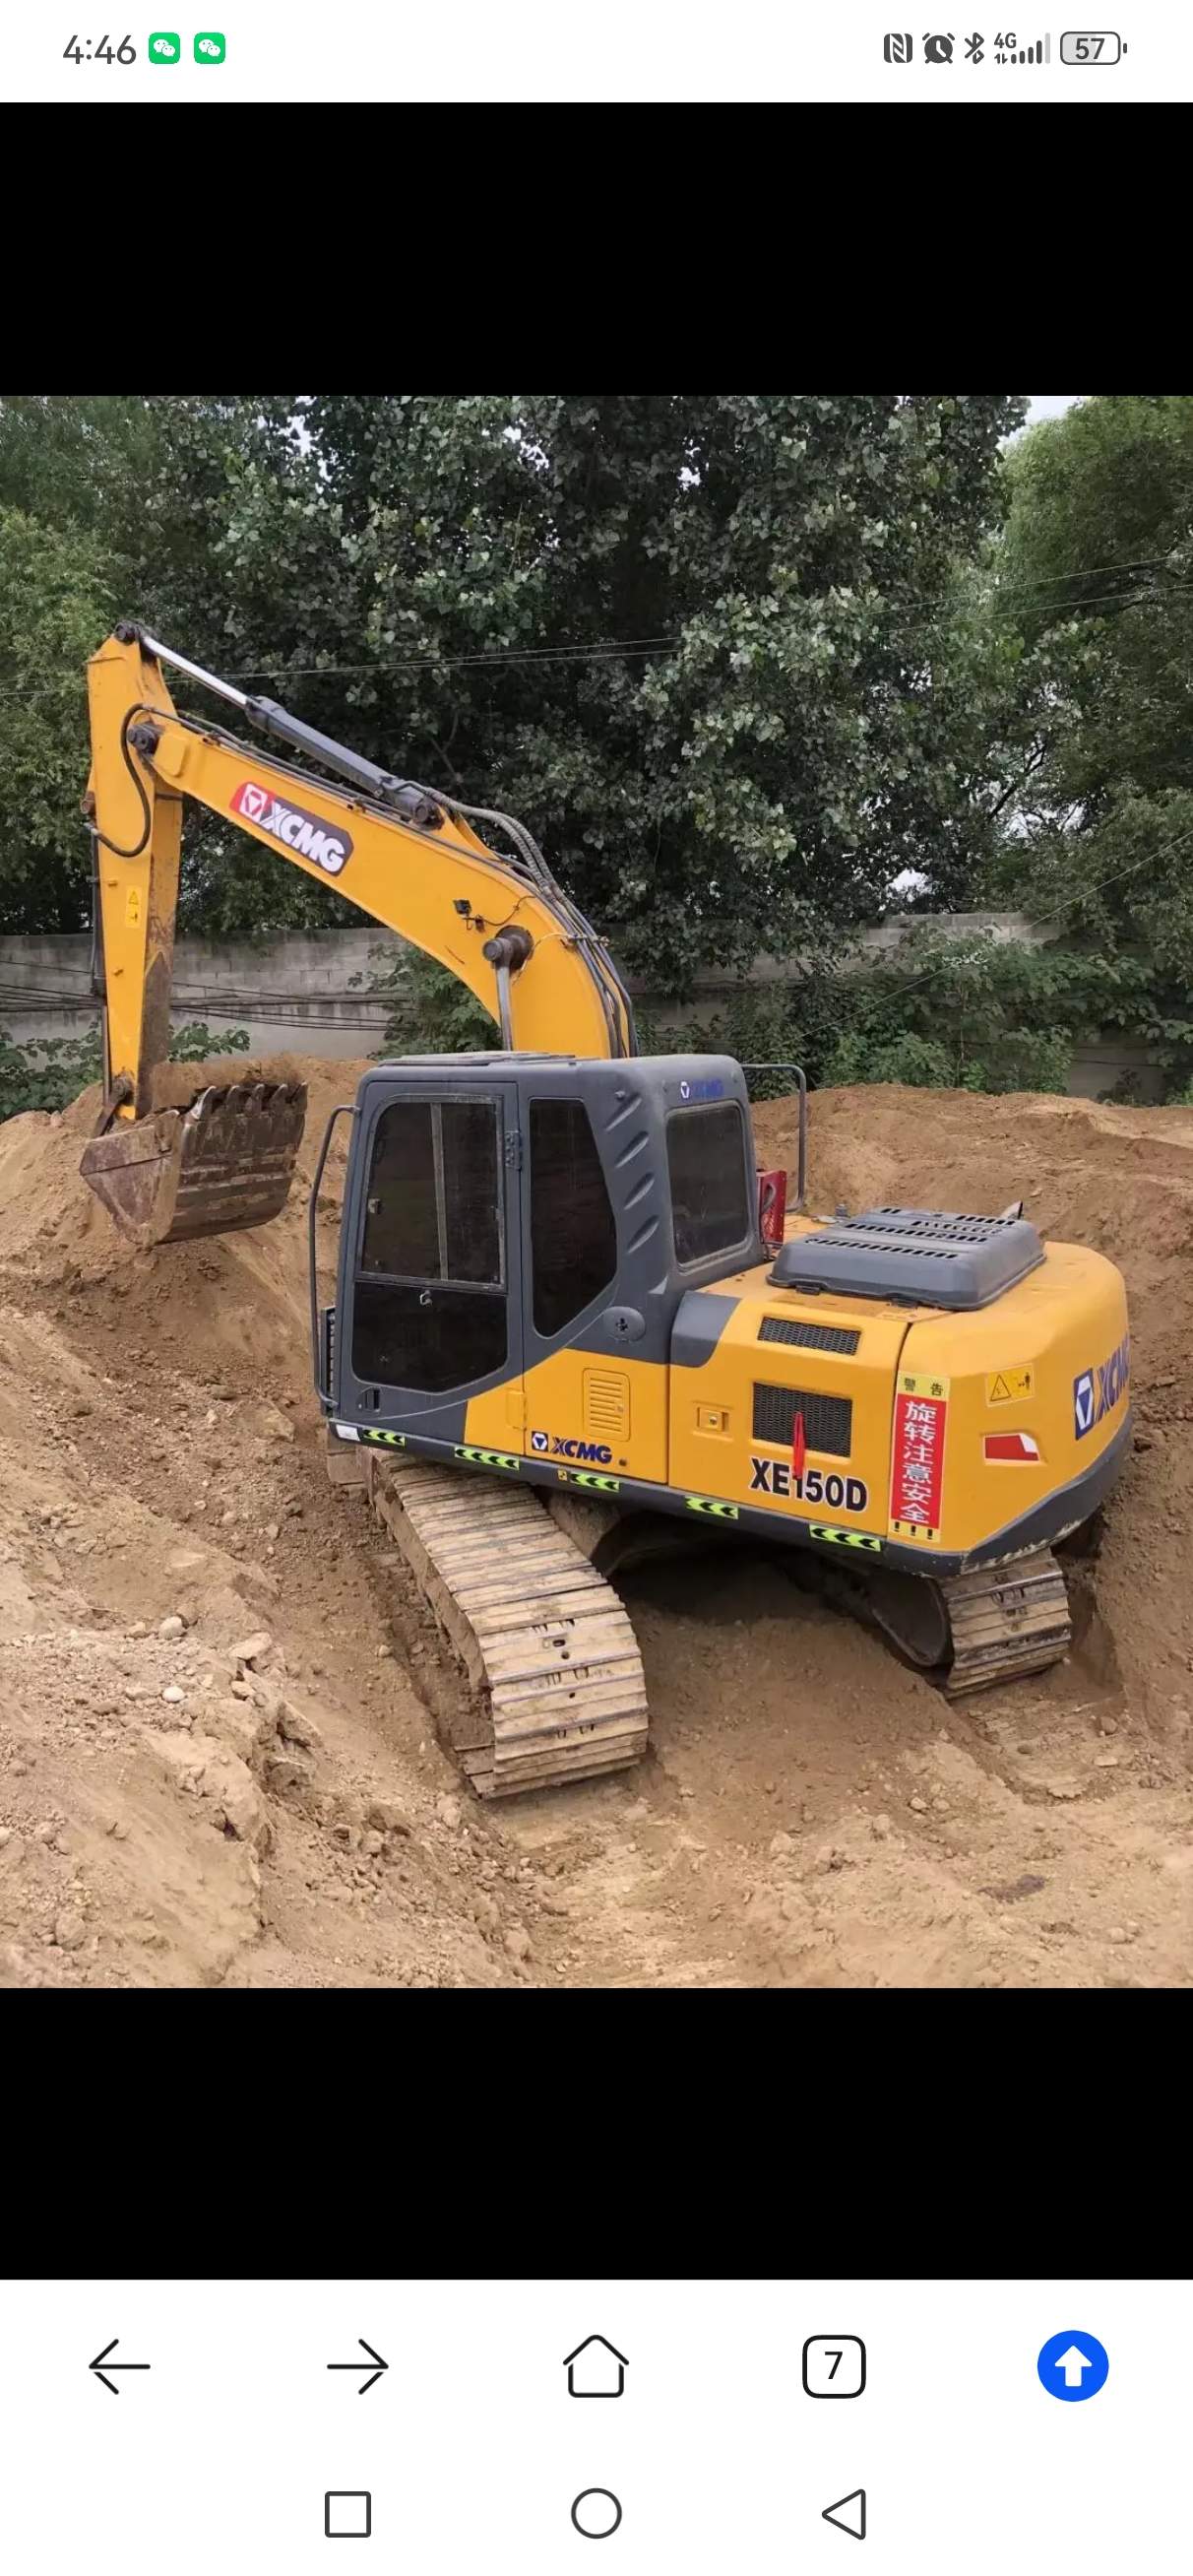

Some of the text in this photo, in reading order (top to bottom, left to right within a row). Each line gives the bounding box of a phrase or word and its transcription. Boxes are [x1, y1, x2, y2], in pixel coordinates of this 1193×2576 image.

[62, 34, 137, 65] 4:46
[993, 32, 1017, 49] 4G
[1075, 37, 1105, 60] 57
[259, 800, 345, 872] XCMG
[904, 1377, 944, 1396] 警告
[550, 1436, 613, 1464] XCMG
[900, 1400, 937, 1524] 旋转注意安全
[749, 1456, 868, 1513] XE150D
[824, 2351, 844, 2380] 7
